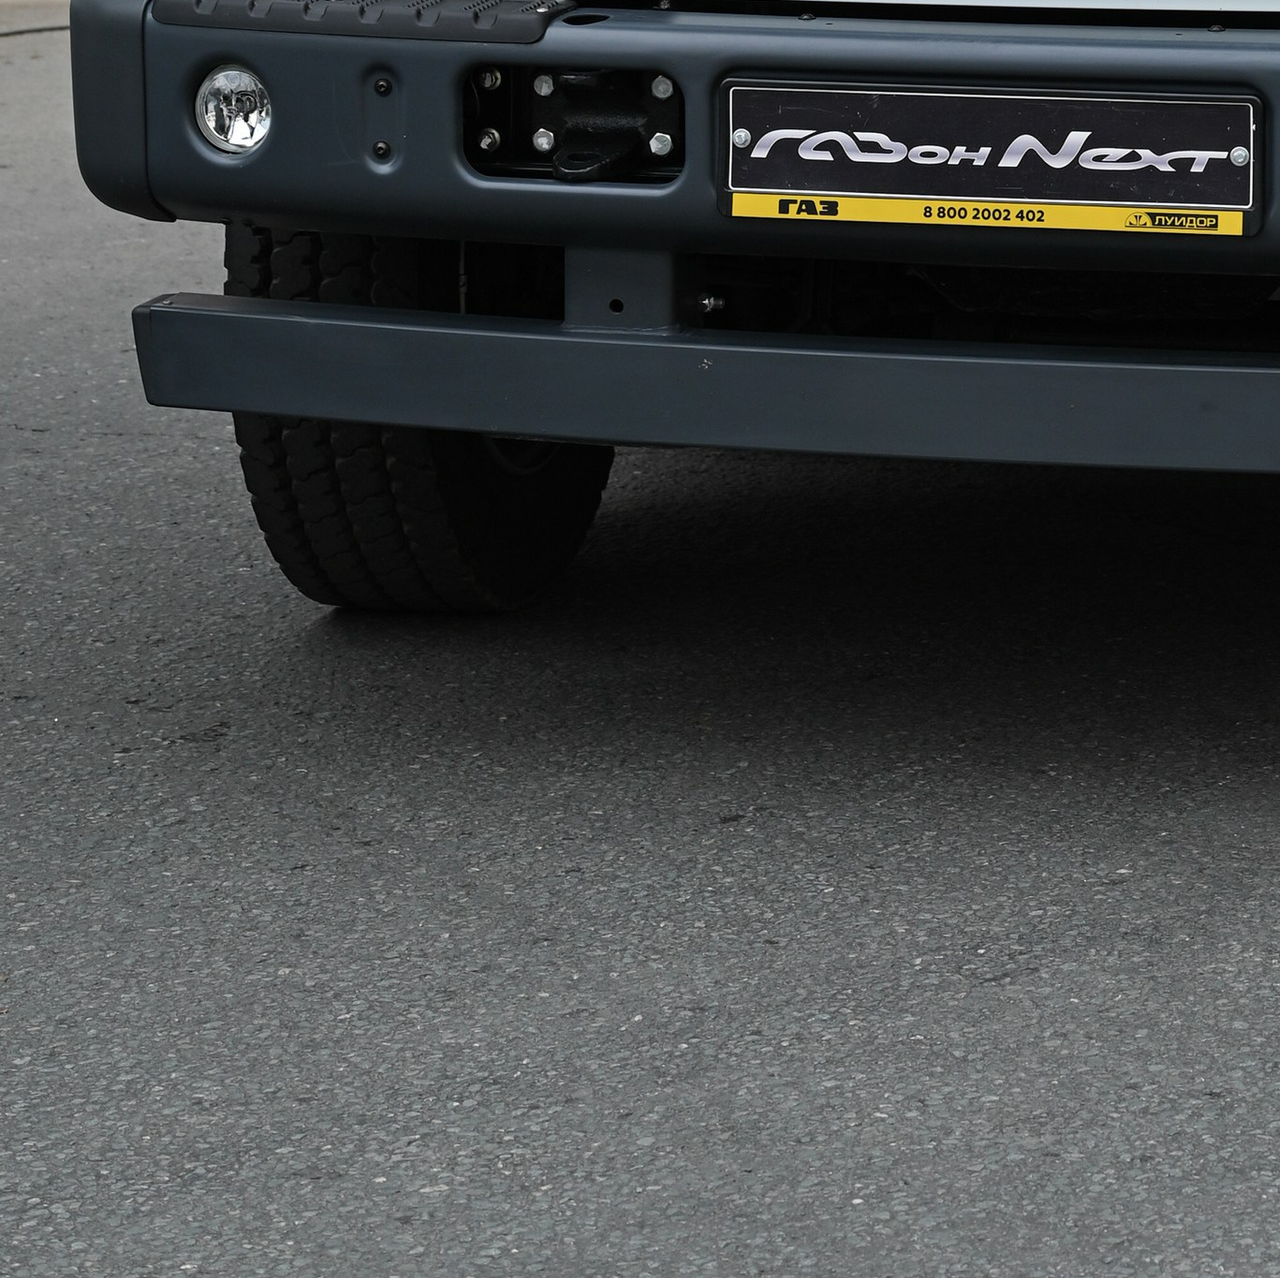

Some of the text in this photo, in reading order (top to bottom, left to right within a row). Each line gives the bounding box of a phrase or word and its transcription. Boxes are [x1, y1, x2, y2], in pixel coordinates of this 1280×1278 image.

[778, 199, 1217, 228] ГАЗ 8 800 2002 402 ЛУИДОР
